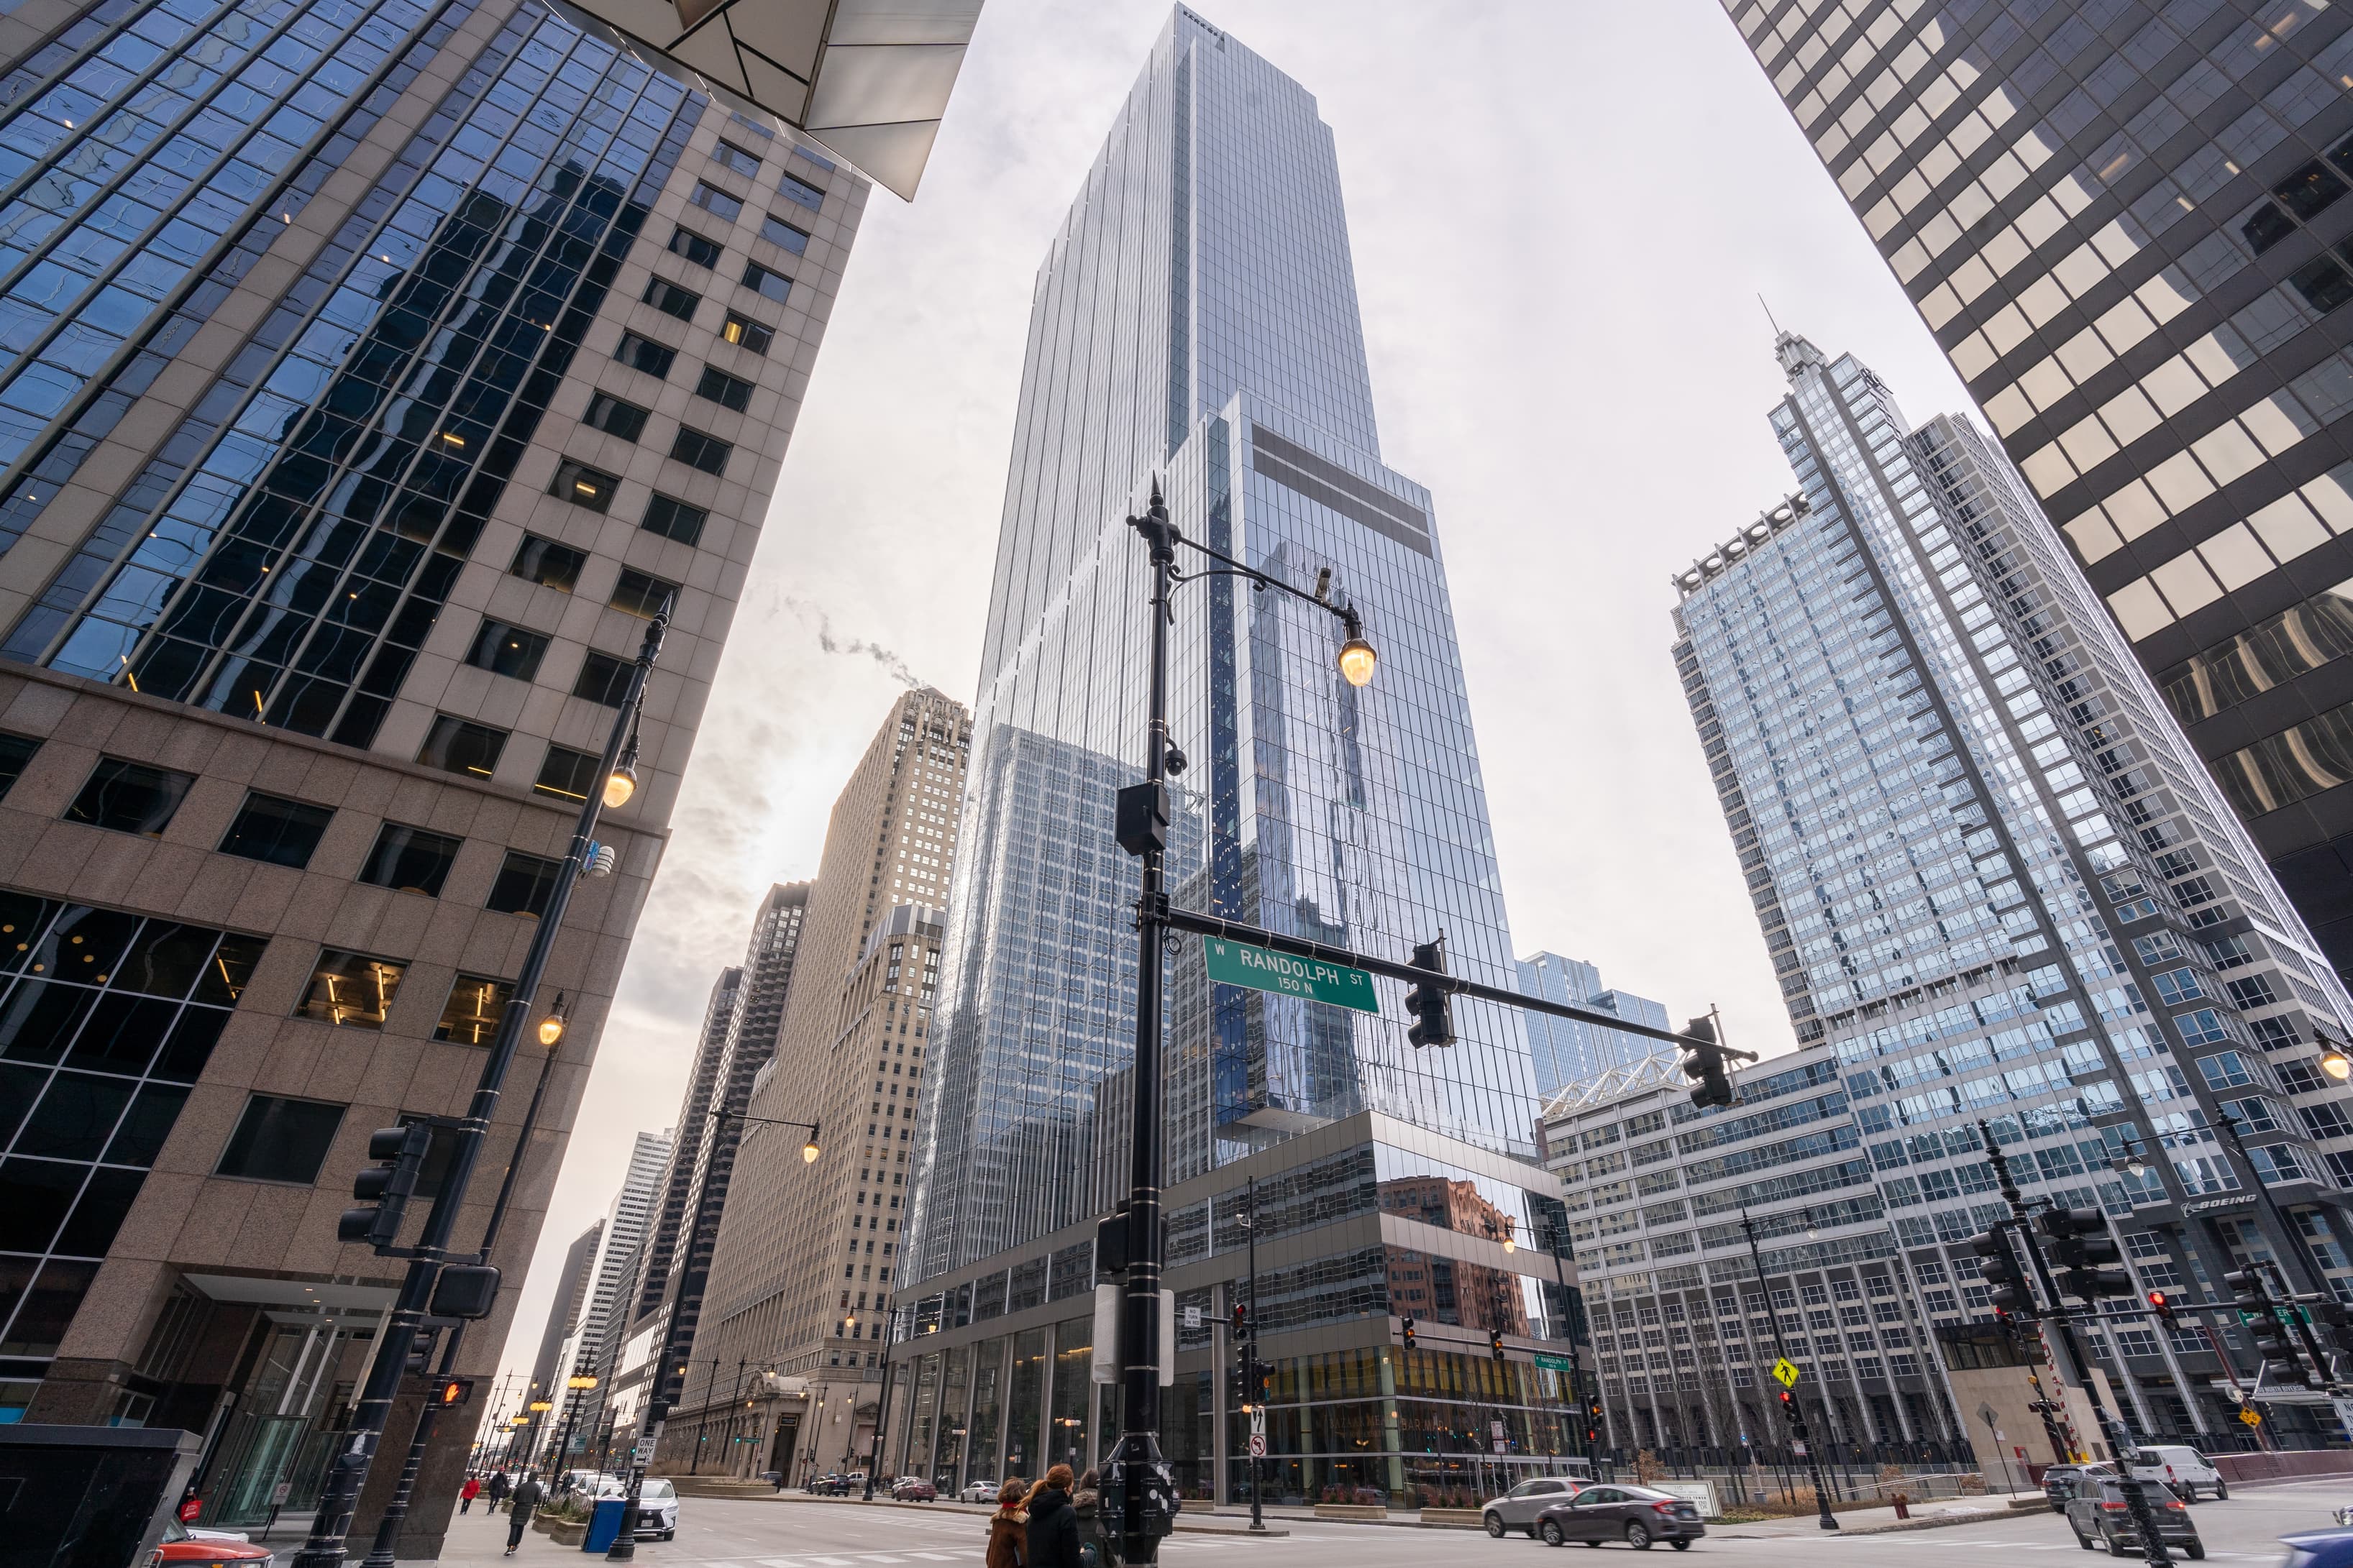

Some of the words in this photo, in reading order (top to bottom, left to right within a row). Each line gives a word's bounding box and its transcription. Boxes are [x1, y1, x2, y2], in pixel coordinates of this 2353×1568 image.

[1215, 943, 1225, 956] W
[1240, 949, 1340, 985] RANDOLPH
[1349, 973, 1363, 986] ST
[1277, 976, 1299, 991] 150
[1304, 982, 1313, 995] N
[2200, 1194, 2257, 1209] BOEING
[1402, 1418, 1421, 1431] BAR
